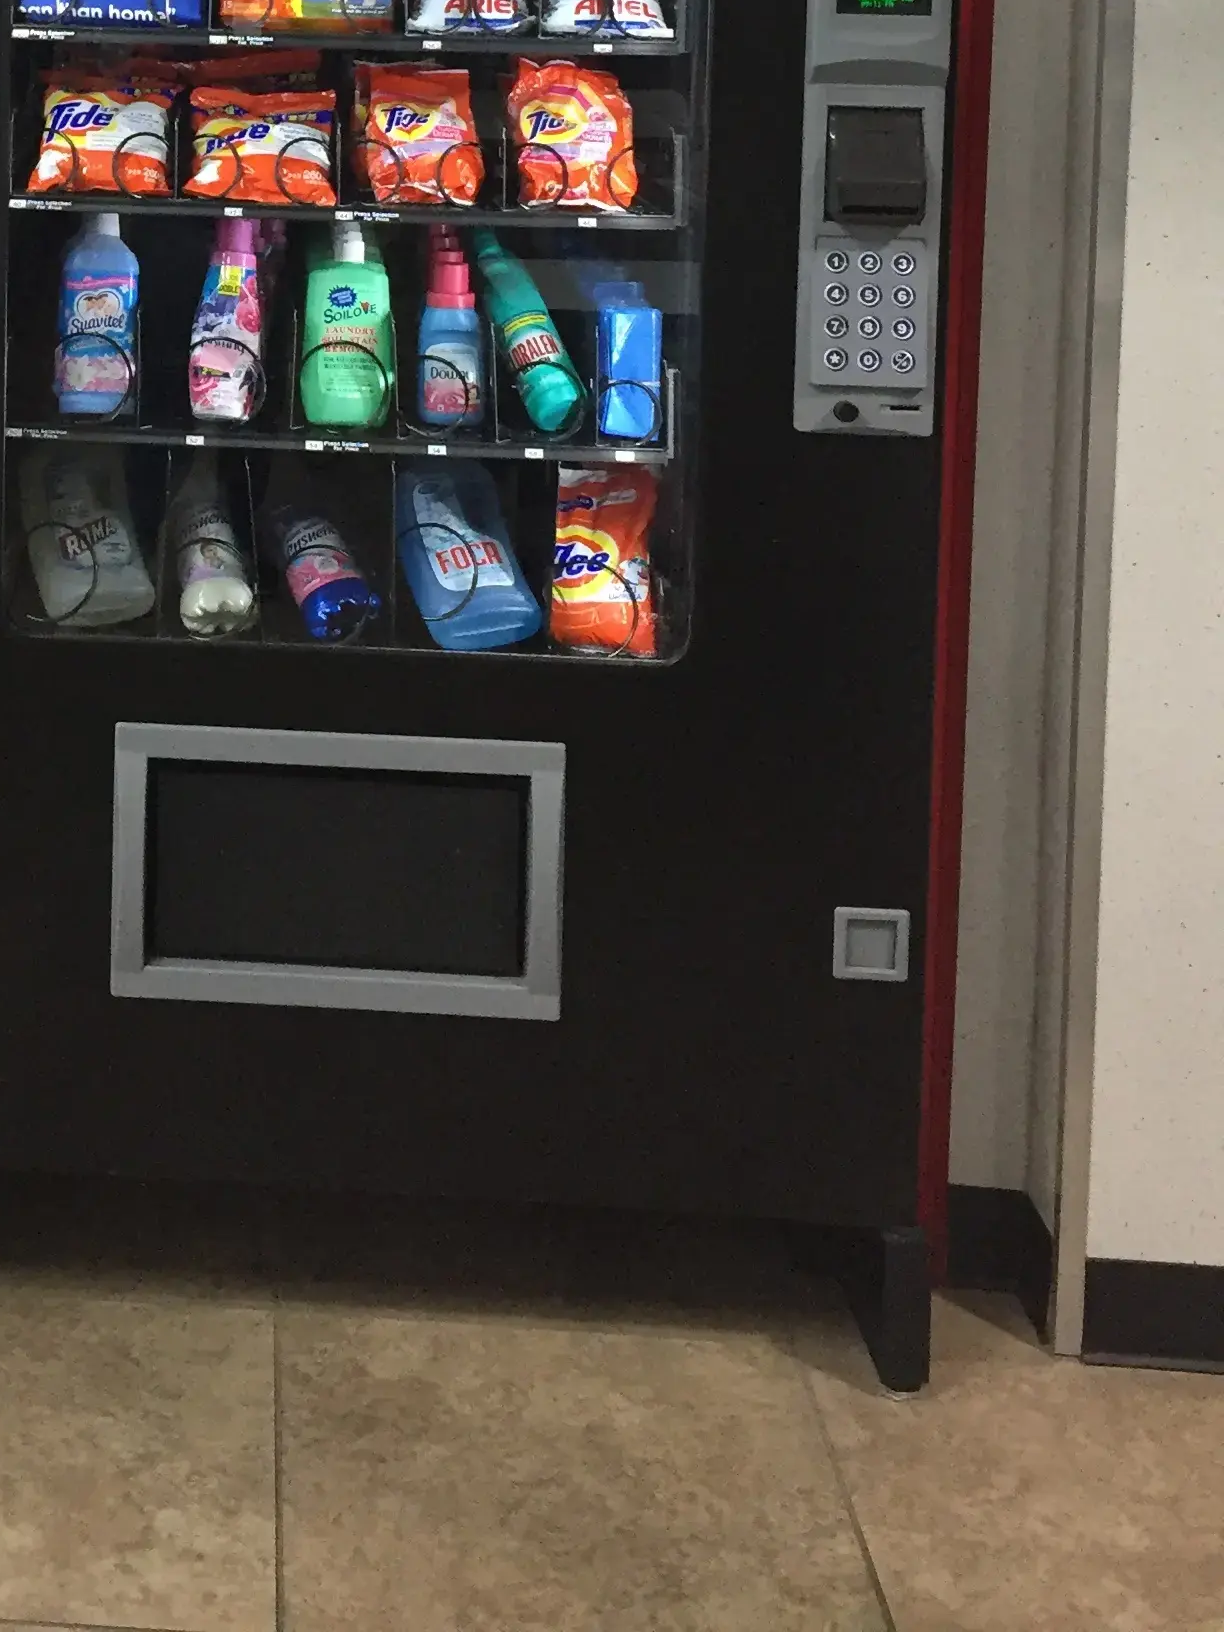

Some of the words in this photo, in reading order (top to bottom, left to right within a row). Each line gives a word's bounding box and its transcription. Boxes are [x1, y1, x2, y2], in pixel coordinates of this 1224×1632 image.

[45, 101, 115, 144] Tide
[70, 314, 125, 334] Suavitel
[325, 327, 375, 335] LAUNDRY
[511, 334, 561, 367] ORALEN
[430, 366, 472, 381] Dow
[65, 517, 118, 561] RMA
[435, 540, 504, 575] FOCA
